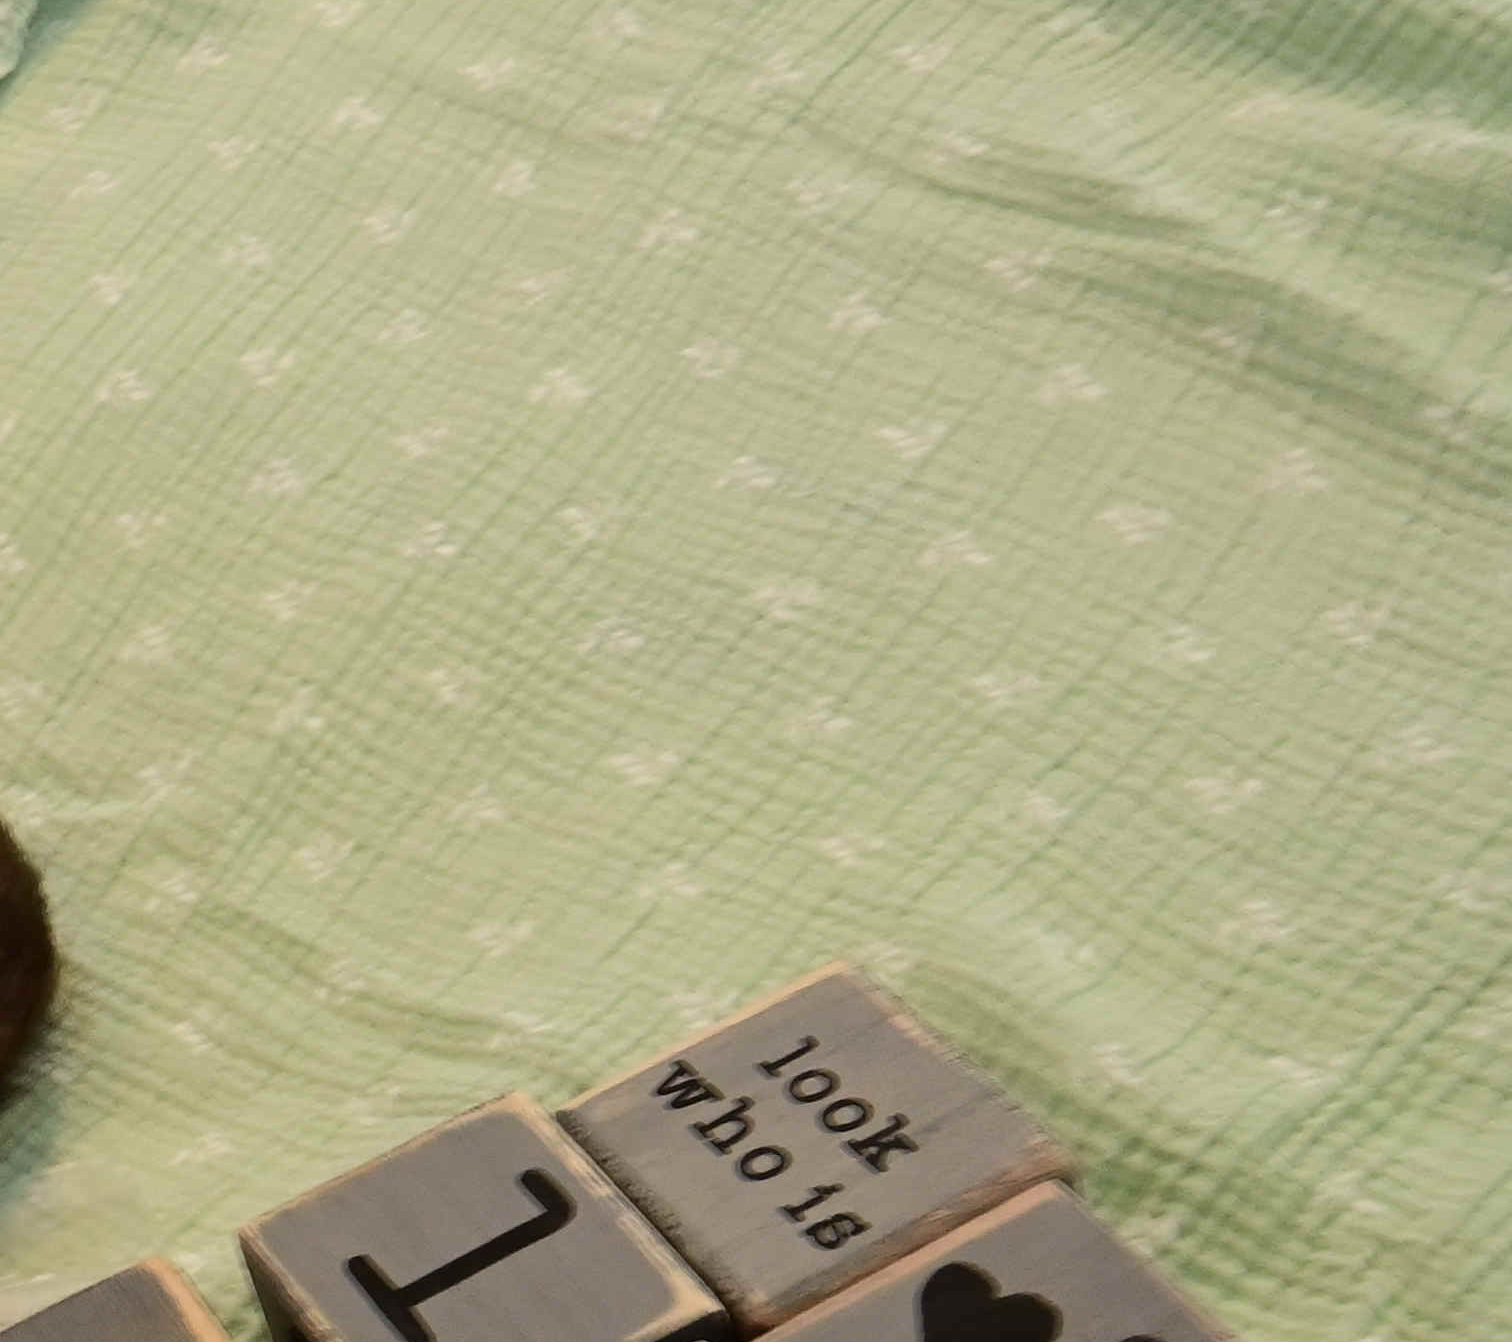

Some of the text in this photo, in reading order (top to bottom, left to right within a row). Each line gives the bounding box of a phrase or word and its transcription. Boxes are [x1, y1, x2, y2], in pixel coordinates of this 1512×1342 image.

[652, 1059, 872, 1251] who is
[757, 1035, 920, 1173] look
